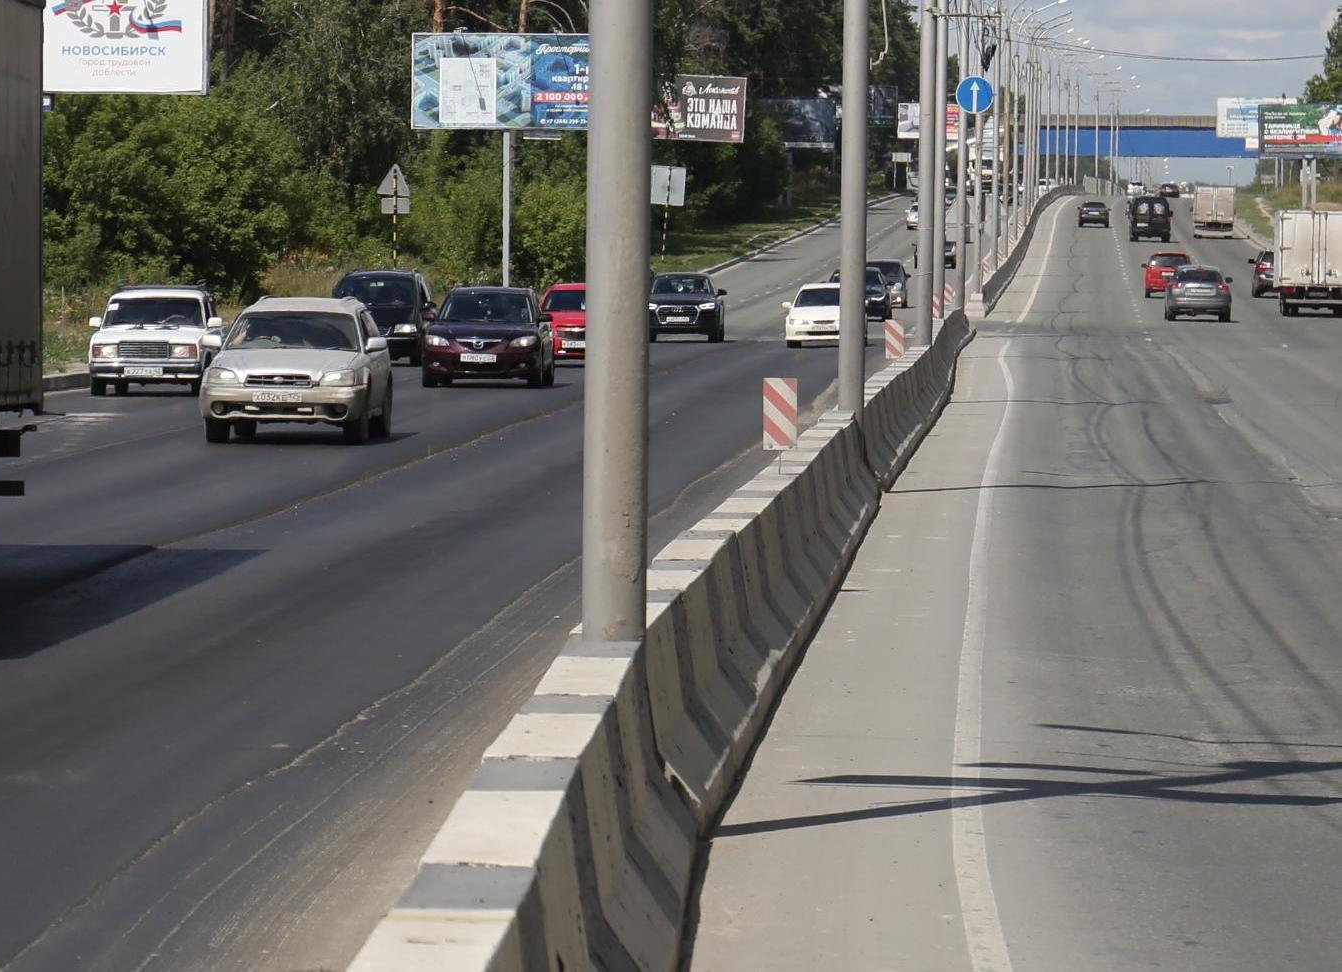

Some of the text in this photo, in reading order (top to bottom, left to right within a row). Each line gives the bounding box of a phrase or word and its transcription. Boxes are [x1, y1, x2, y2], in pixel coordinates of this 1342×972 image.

[61, 45, 166, 57] НОВОСИБИРСК
[687, 97, 737, 114] ЭТО НАША
[687, 113, 737, 130] КОМАНДА
